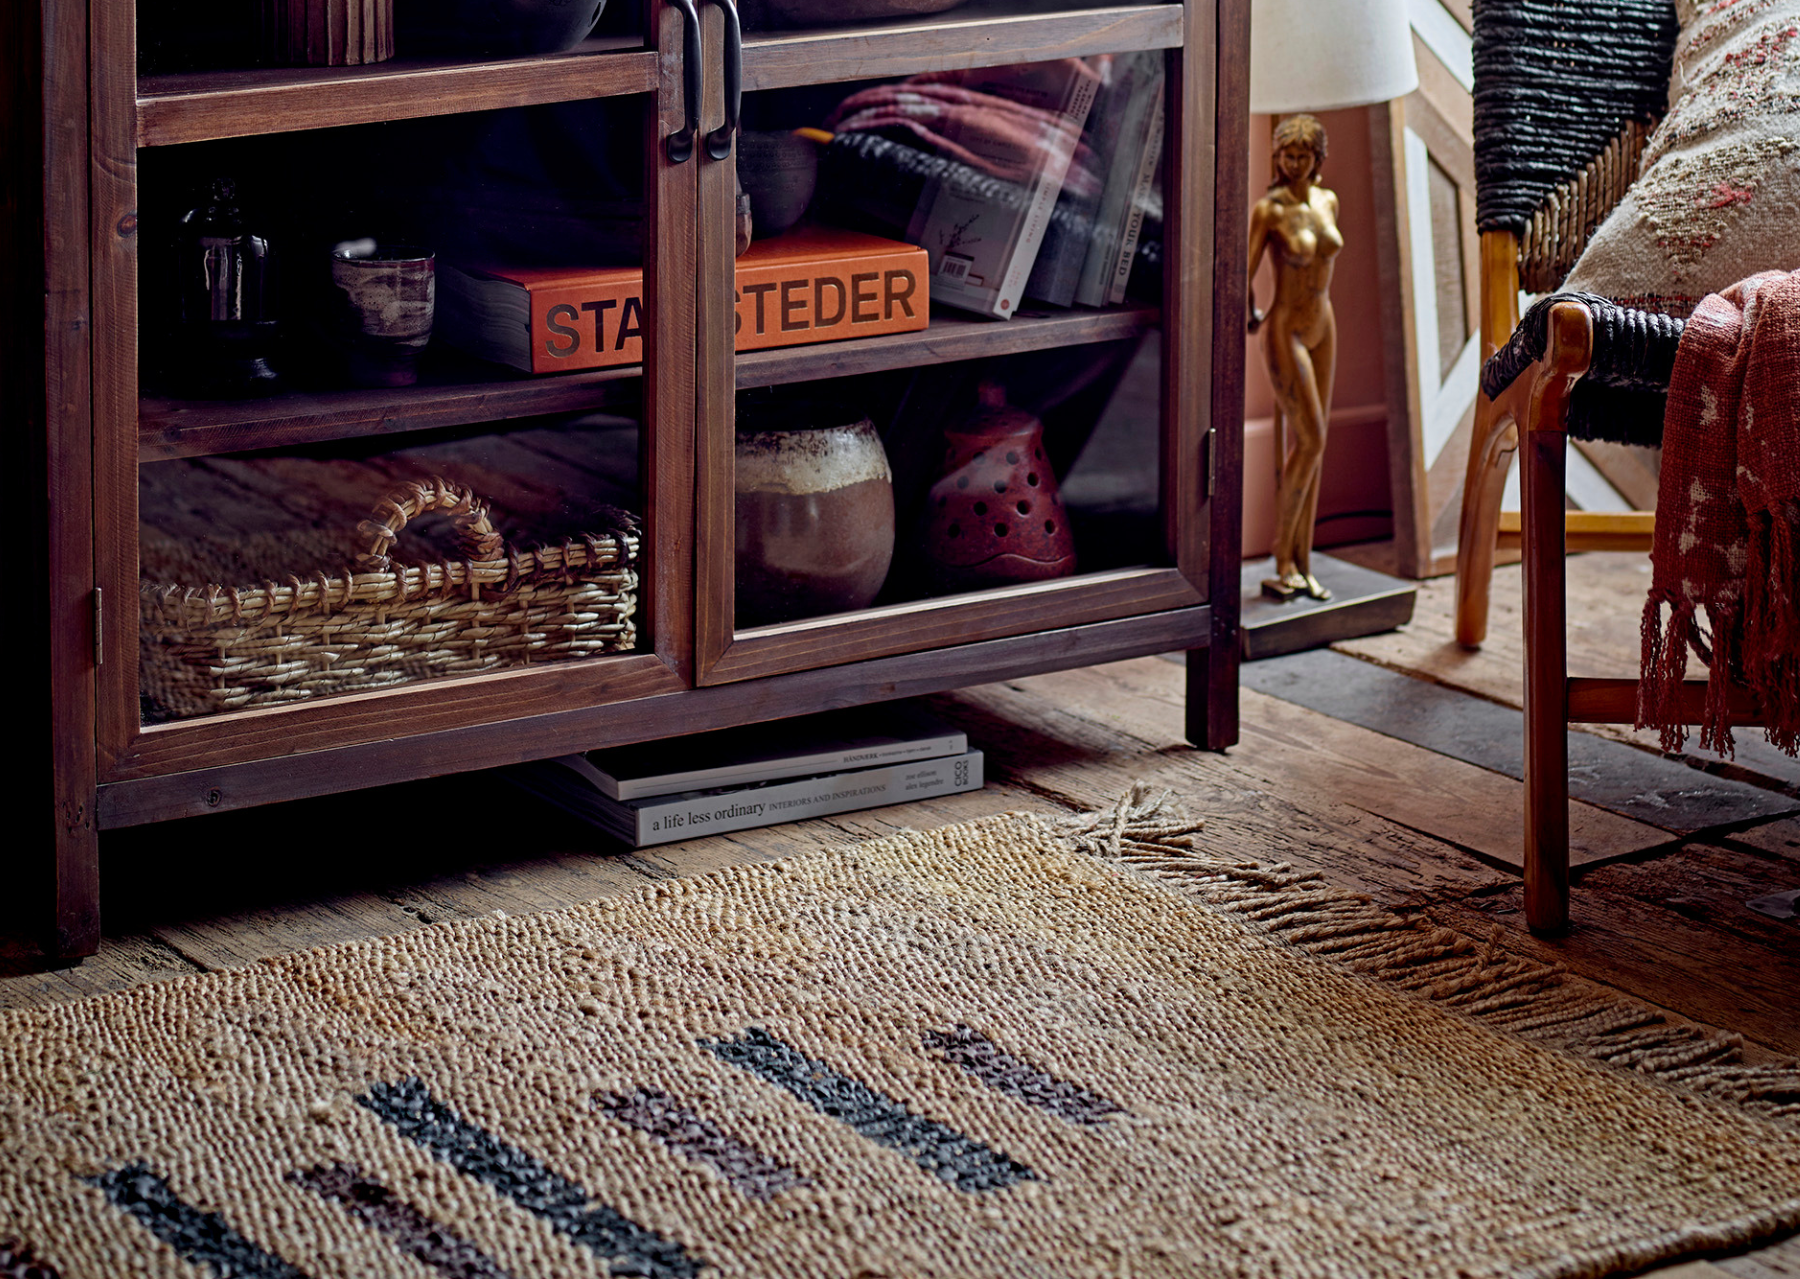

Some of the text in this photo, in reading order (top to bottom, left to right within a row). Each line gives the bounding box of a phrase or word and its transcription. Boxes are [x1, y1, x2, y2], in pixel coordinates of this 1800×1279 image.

[1125, 211, 1142, 247] YOUR
[1118, 251, 1132, 276] BED
[954, 761, 963, 787] CICO
[652, 784, 887, 831] a life less ordinary INTERIORS AND INSPIRATIONS
